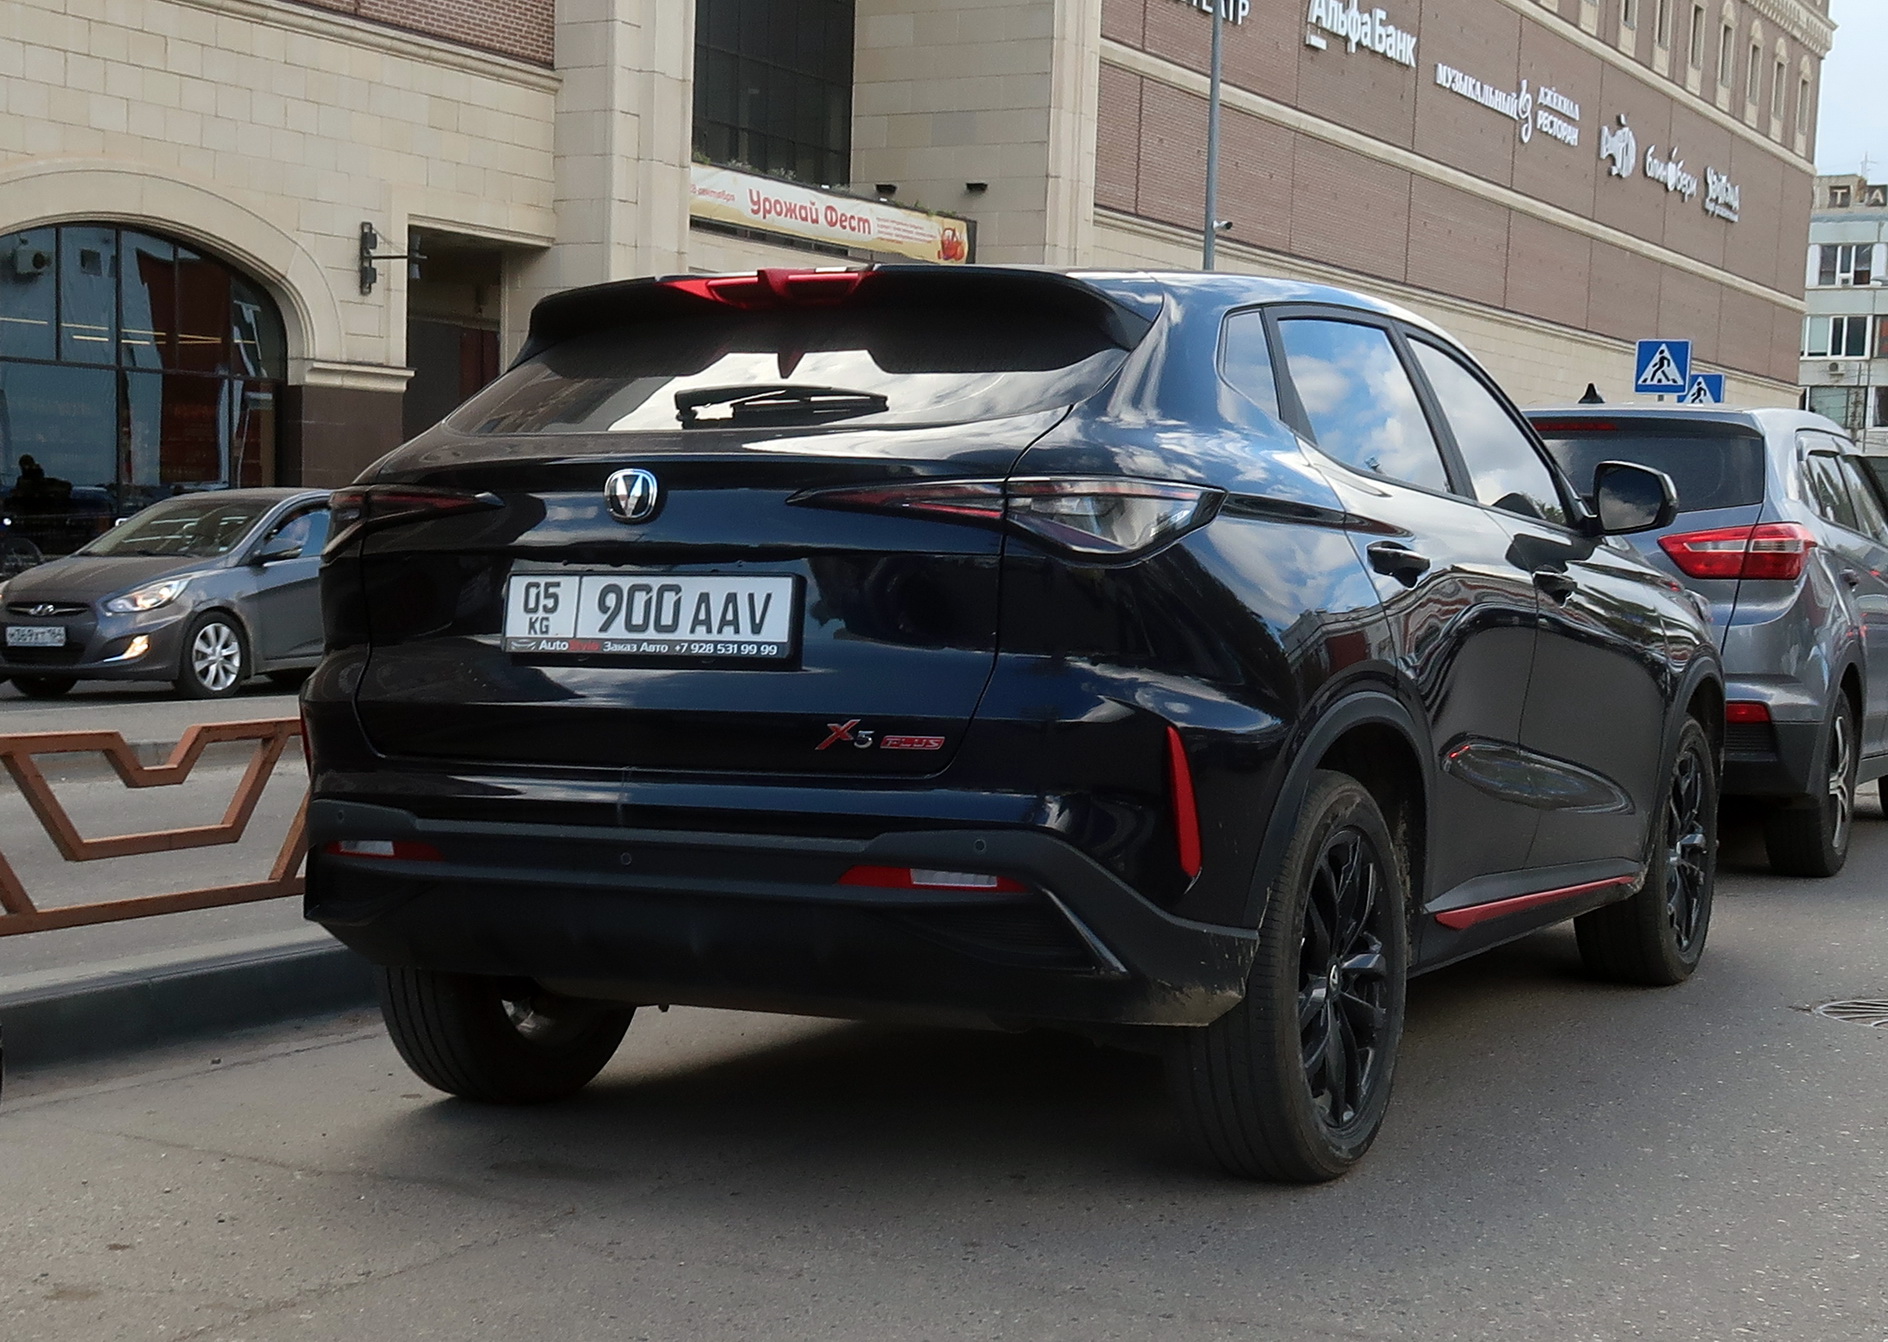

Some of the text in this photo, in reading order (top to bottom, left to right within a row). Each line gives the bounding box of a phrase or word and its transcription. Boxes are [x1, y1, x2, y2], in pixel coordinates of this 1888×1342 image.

[1436, 63, 1518, 120] МУЗЫКАЛЬНЫЙ
[1536, 110, 1579, 146] РЕСТОРАН
[749, 188, 819, 225] Урожай
[824, 205, 872, 235] Фест
[523, 581, 773, 635] 05 900 AAV
[527, 616, 551, 636] KG
[603, 641, 637, 652] Заказ
[640, 642, 669, 653] Авто
[675, 643, 689, 653] +7
[691, 643, 714, 654] 928
[717, 643, 738, 654] 531
[740, 644, 757, 655] 99
[760, 645, 778, 655] 99
